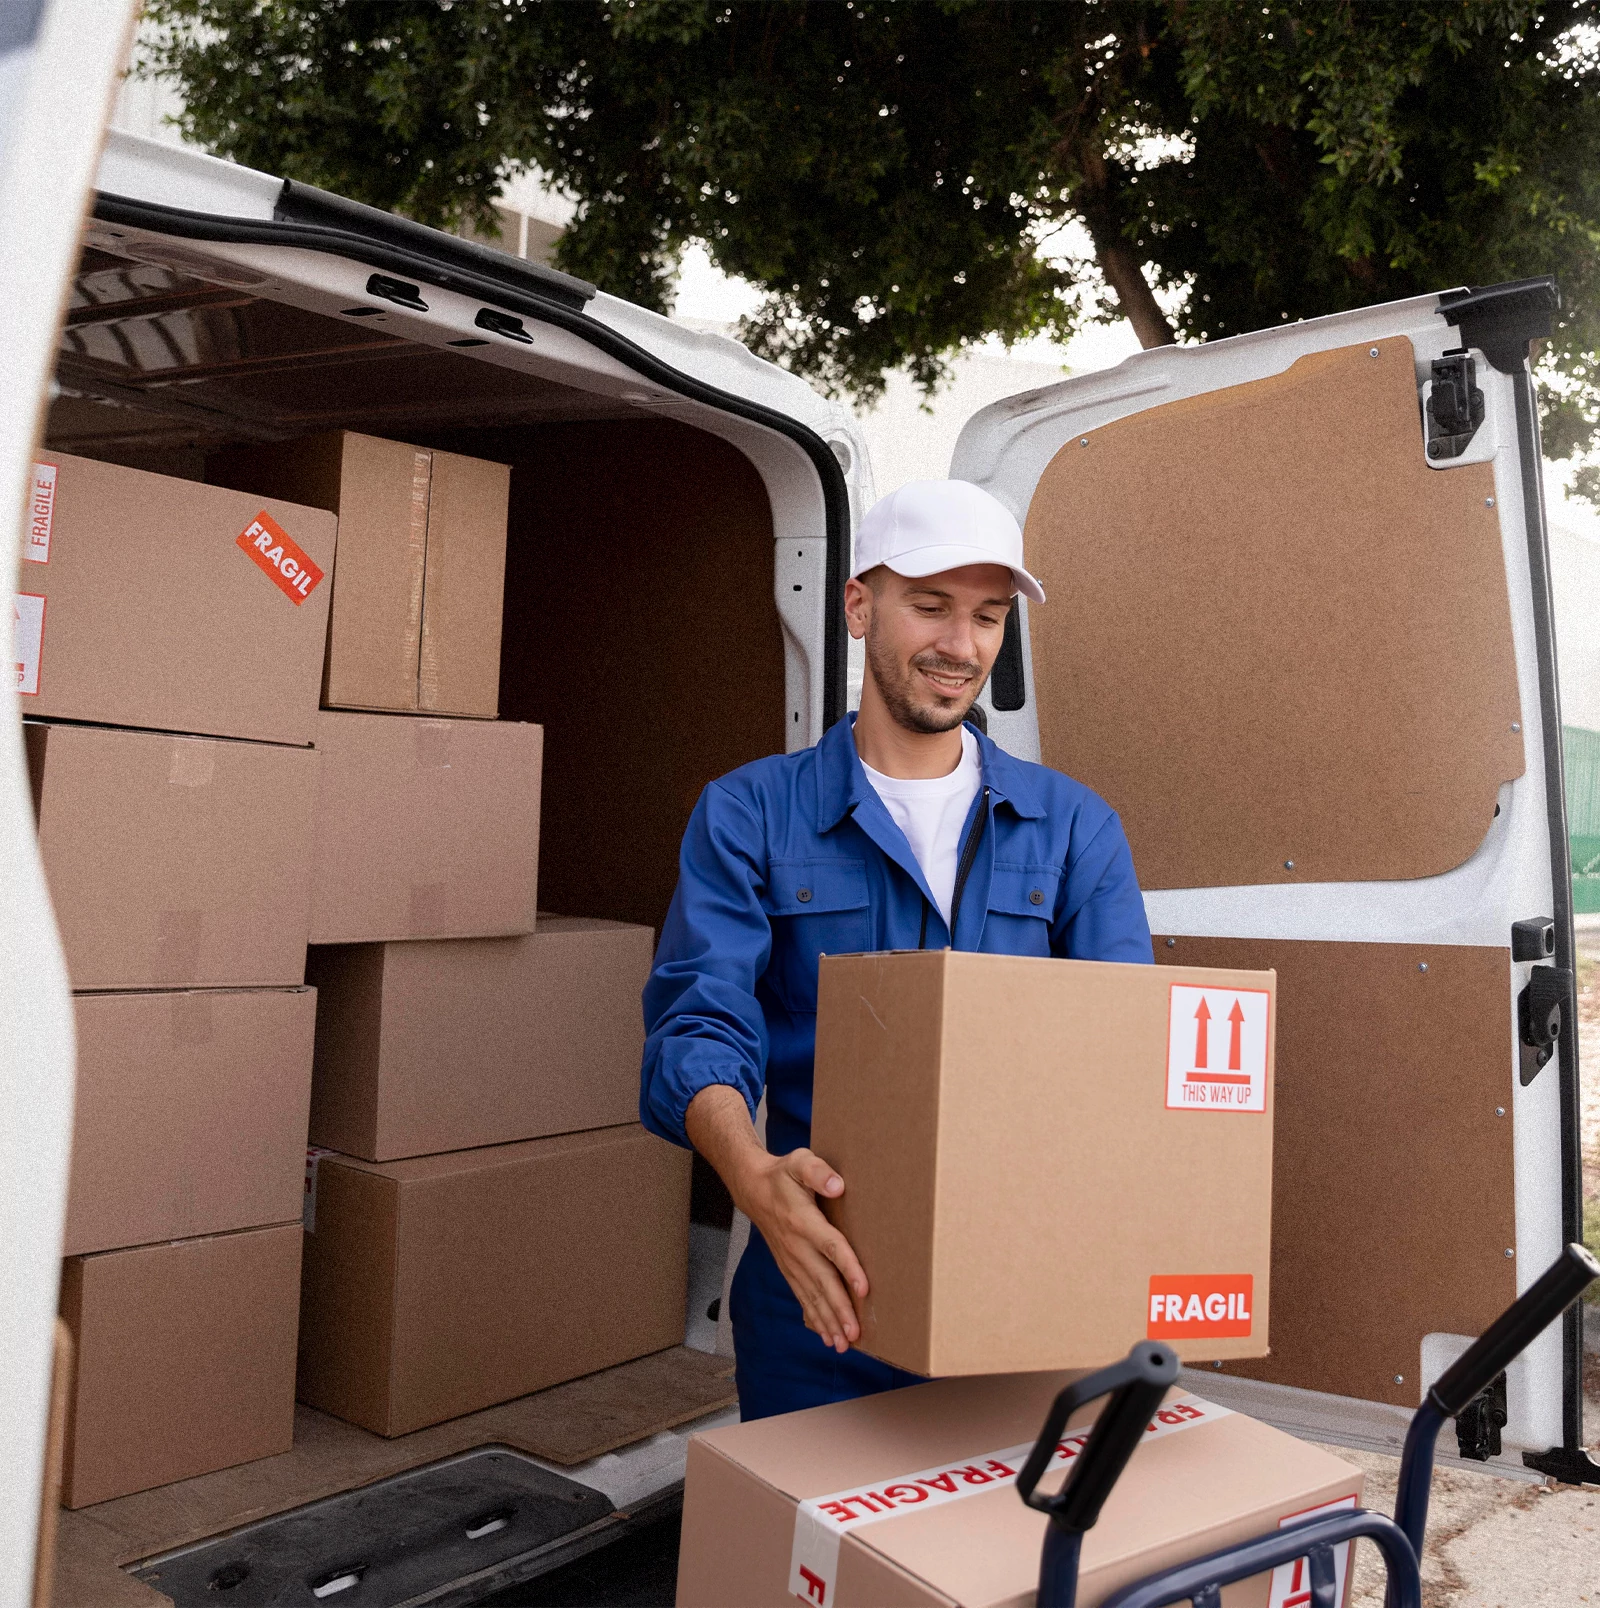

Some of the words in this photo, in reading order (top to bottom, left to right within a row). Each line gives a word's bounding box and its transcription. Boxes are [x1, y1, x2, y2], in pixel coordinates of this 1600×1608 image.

[31, 479, 53, 547] FRAGILE
[244, 520, 312, 596] FRAGIL
[1182, 1084, 1206, 1102] THIS
[1210, 1085, 1233, 1103] WAY
[1237, 1087, 1252, 1104] UP
[1150, 1293, 1250, 1322] FRAGIL
[818, 1459, 1017, 1523] FRAGILE
